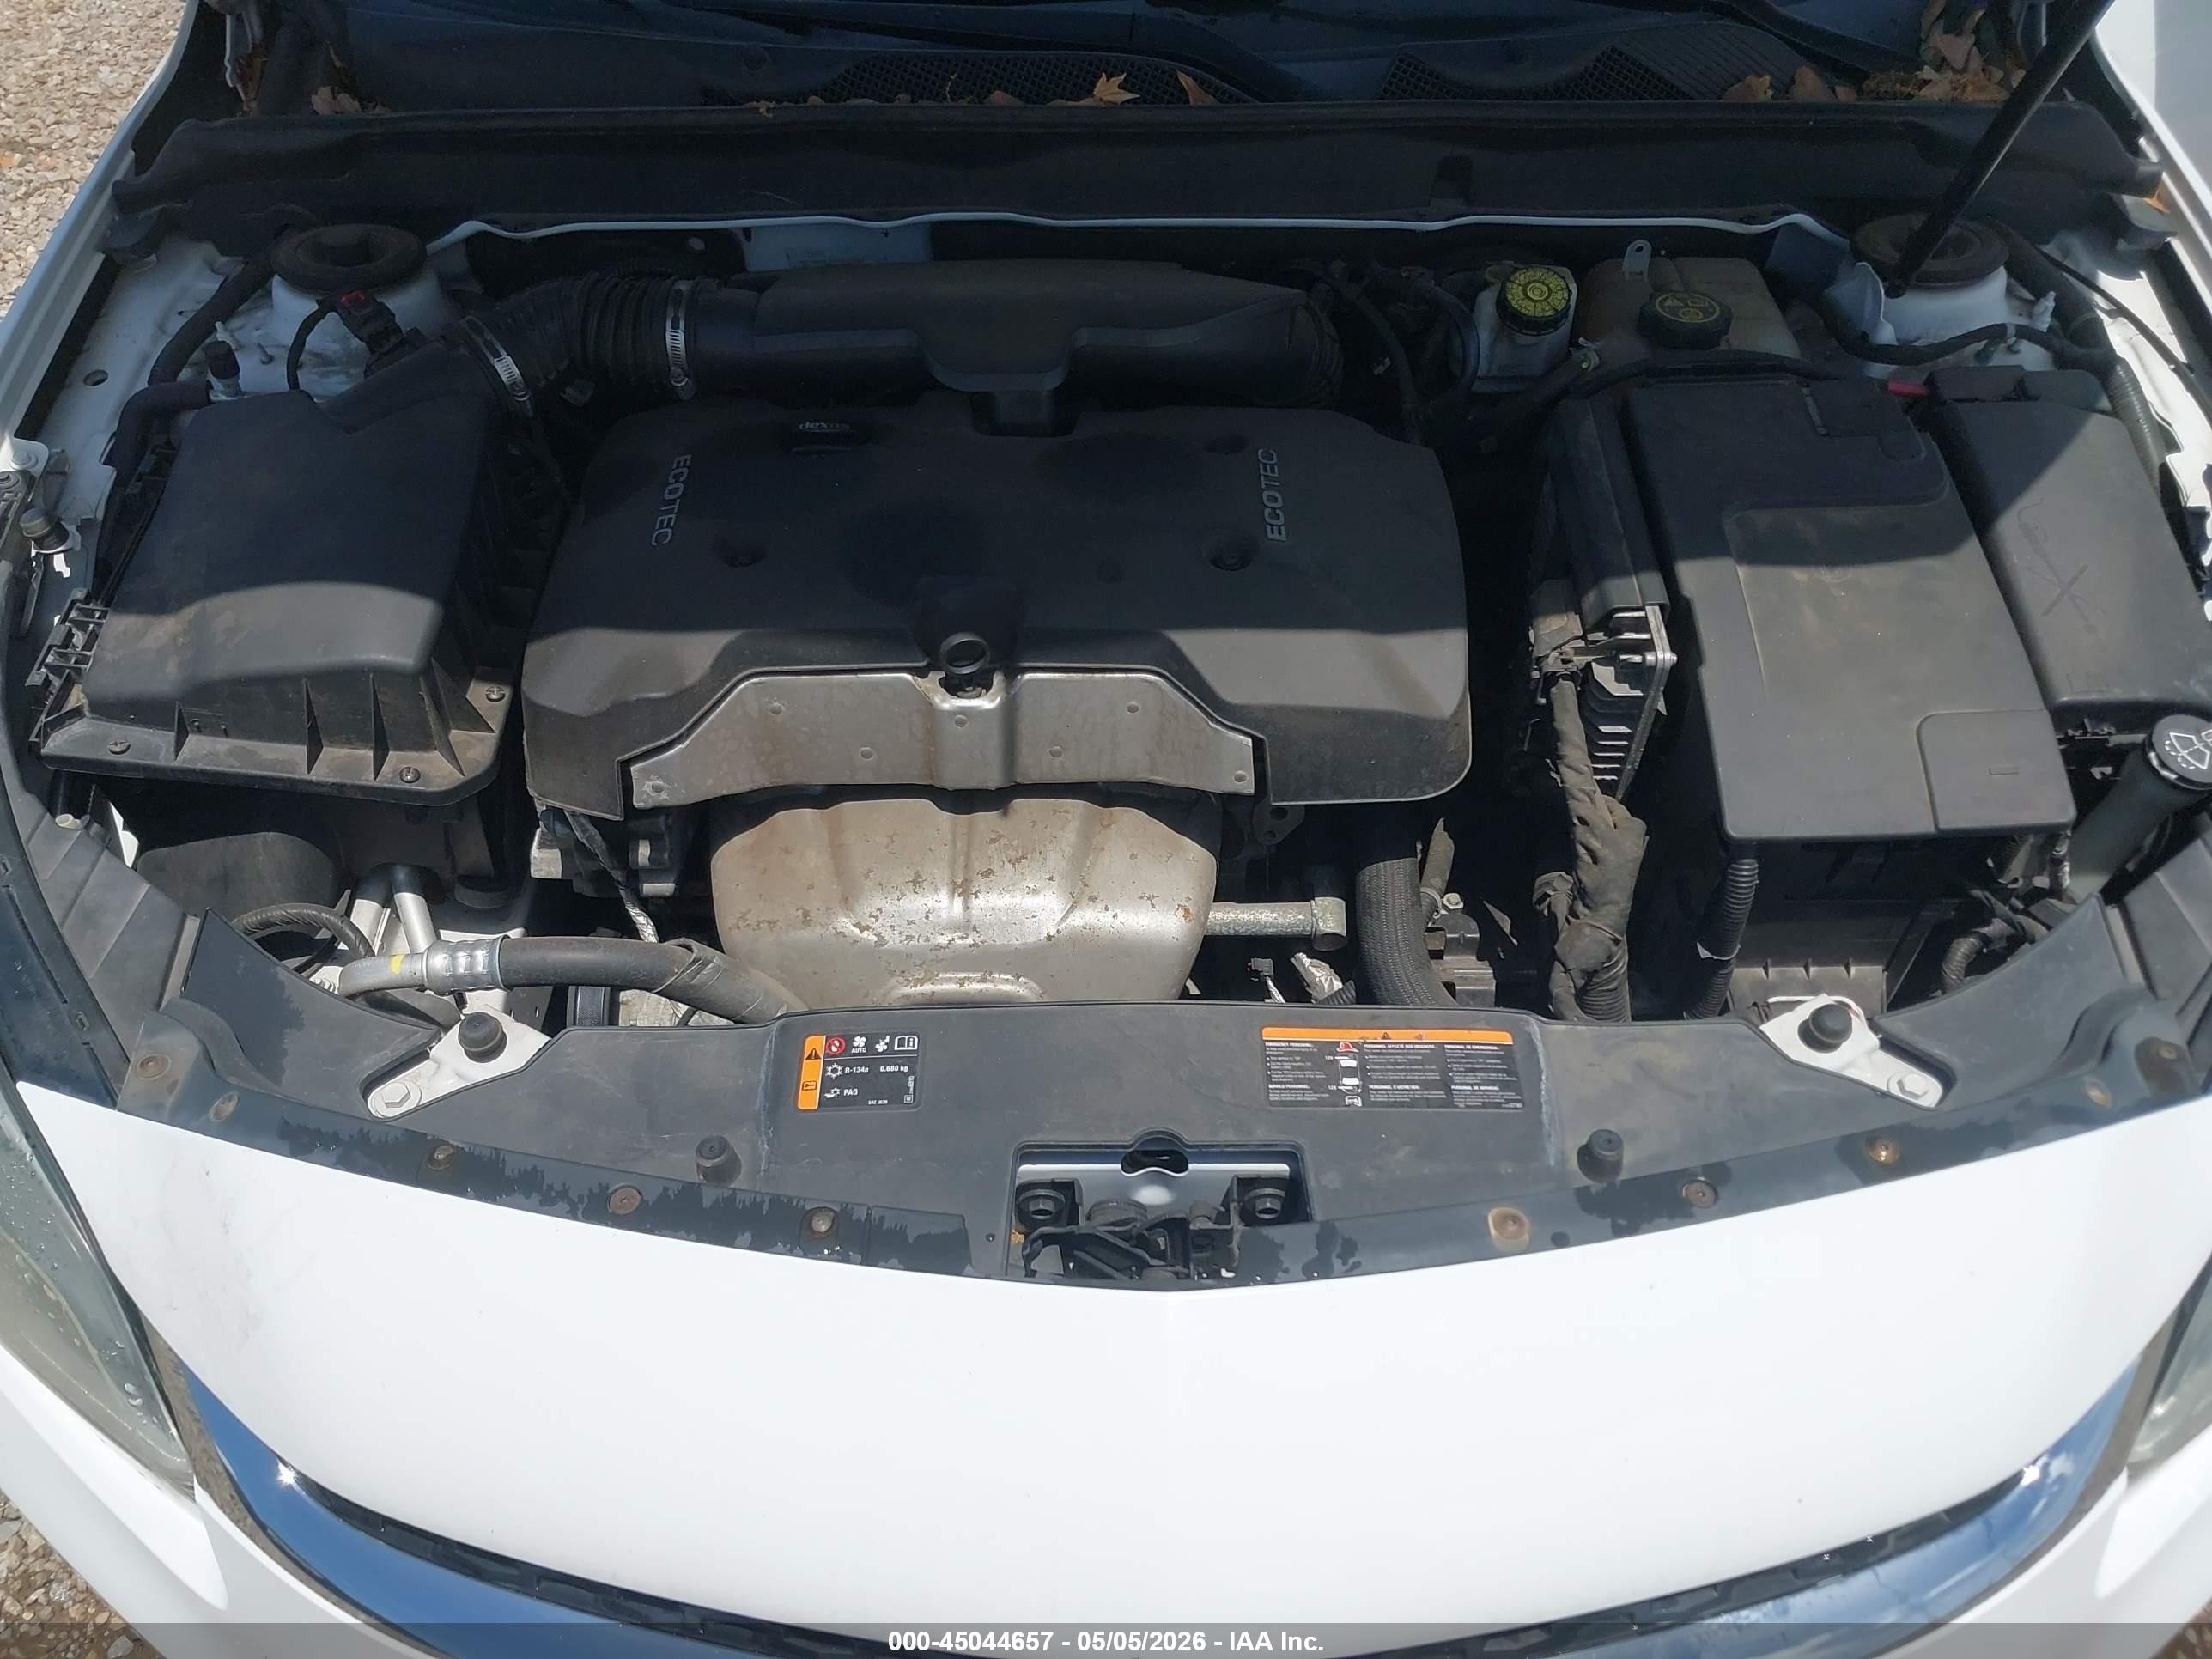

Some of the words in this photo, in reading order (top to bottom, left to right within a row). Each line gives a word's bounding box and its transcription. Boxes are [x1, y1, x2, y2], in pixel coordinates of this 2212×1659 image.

[798, 421, 851, 431] dexos
[652, 454, 692, 545] ECOTEC
[1257, 448, 1286, 542] ECOTEC
